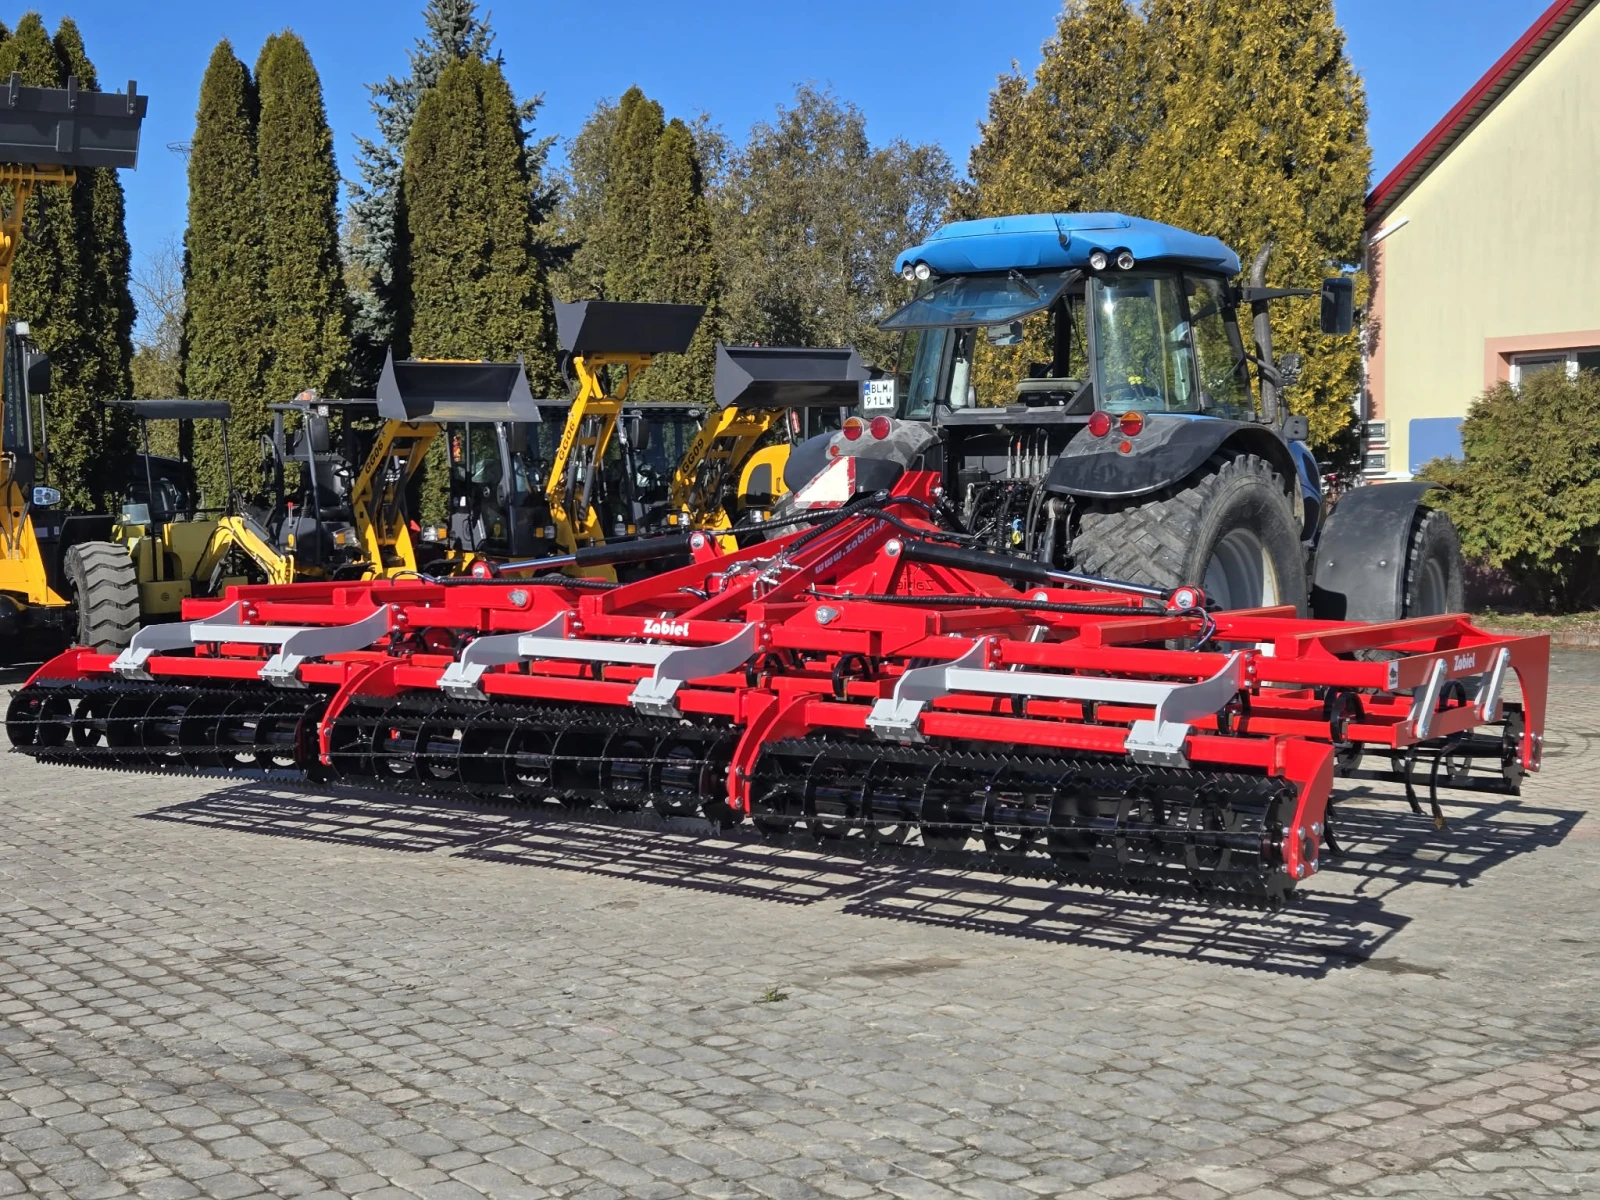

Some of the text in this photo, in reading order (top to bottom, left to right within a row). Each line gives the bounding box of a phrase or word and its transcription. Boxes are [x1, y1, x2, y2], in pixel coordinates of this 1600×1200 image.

[365, 440, 384, 474] GG06
[558, 421, 575, 460] GG06
[682, 438, 704, 473] GG09
[814, 517, 889, 574] www.zabiel.p
[643, 619, 690, 637] Zabiel
[1453, 652, 1476, 672] Zabiel
